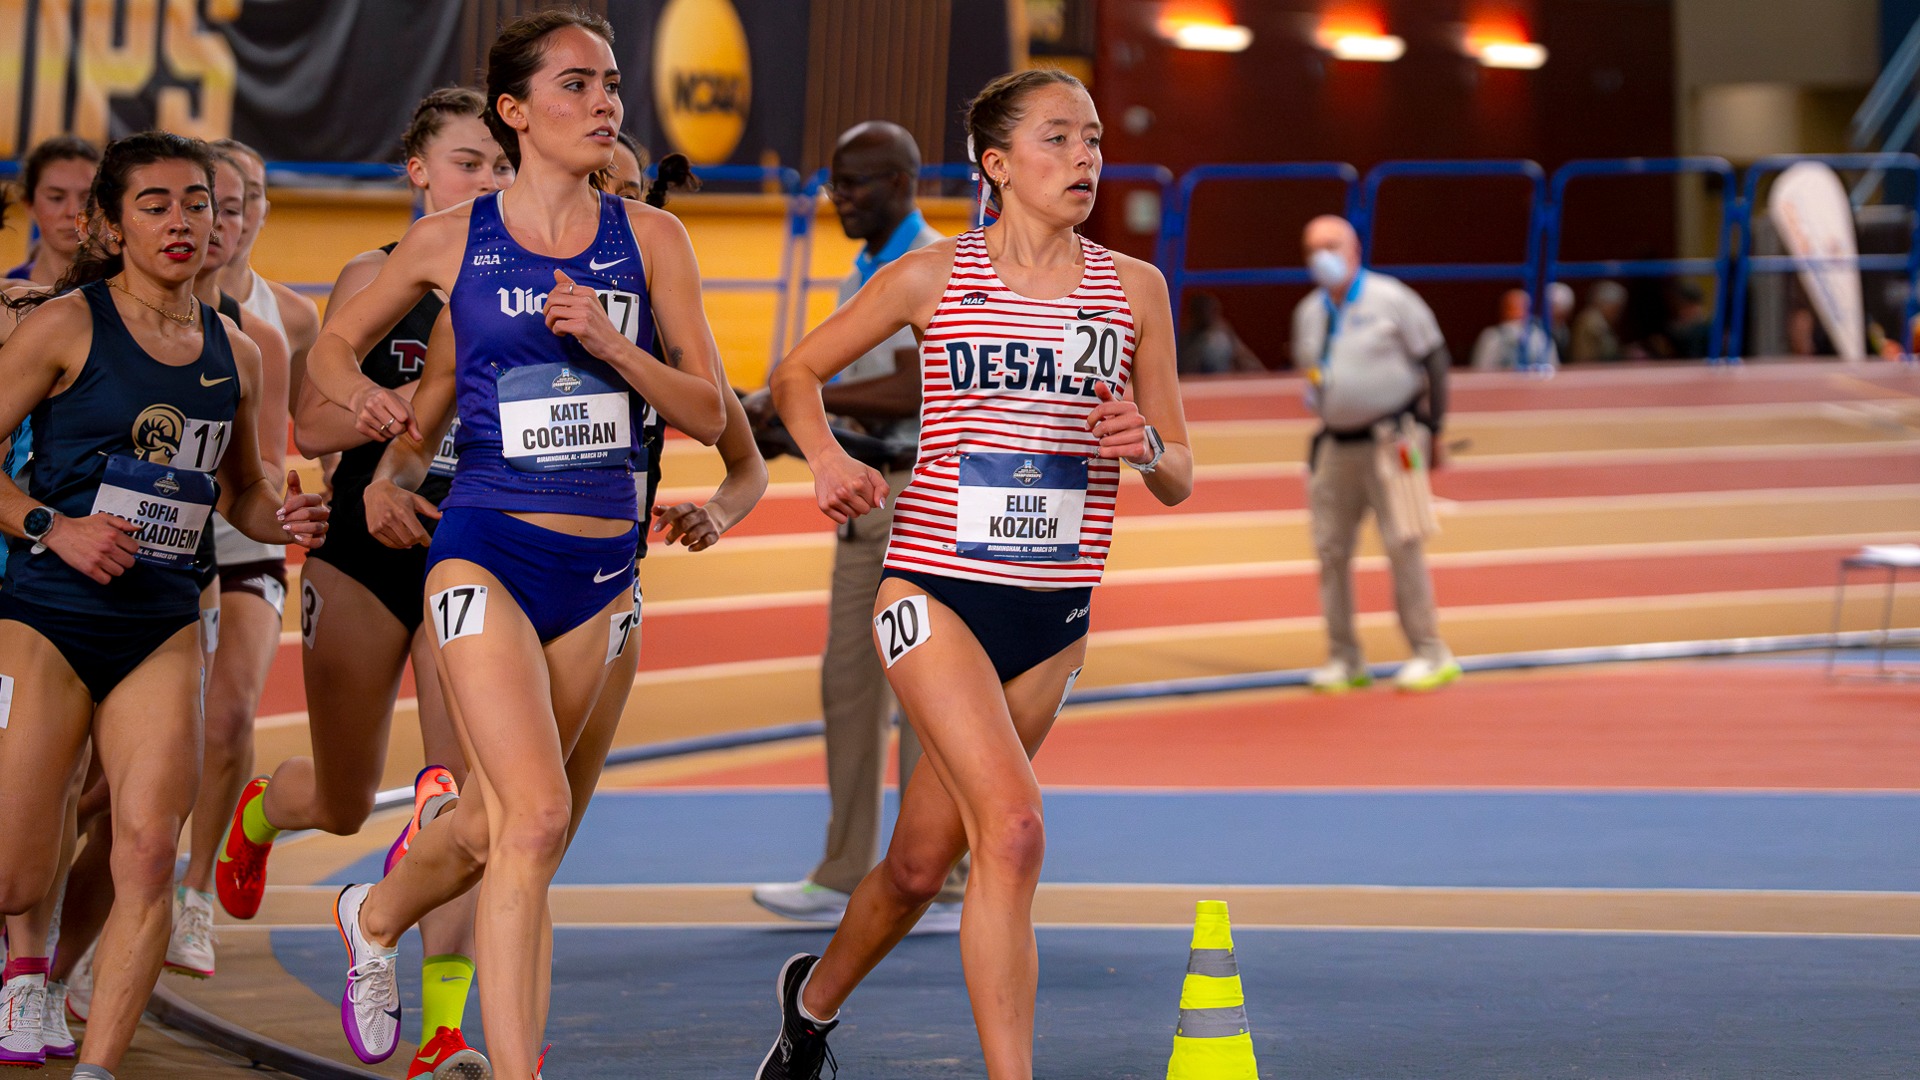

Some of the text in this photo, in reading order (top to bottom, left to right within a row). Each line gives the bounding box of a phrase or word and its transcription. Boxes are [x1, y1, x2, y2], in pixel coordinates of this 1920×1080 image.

[473, 254, 501, 266] UAA
[962, 297, 986, 305] MAC
[1074, 325, 1118, 378] 20
[550, 402, 589, 422] KATE
[194, 423, 226, 469] 11
[522, 422, 616, 450] COCHRAN
[137, 500, 179, 524] SOFIA
[1006, 495, 1047, 513] ELLIE
[989, 516, 1059, 539] KOZICH
[438, 587, 476, 641] 17
[881, 599, 919, 661] 20
